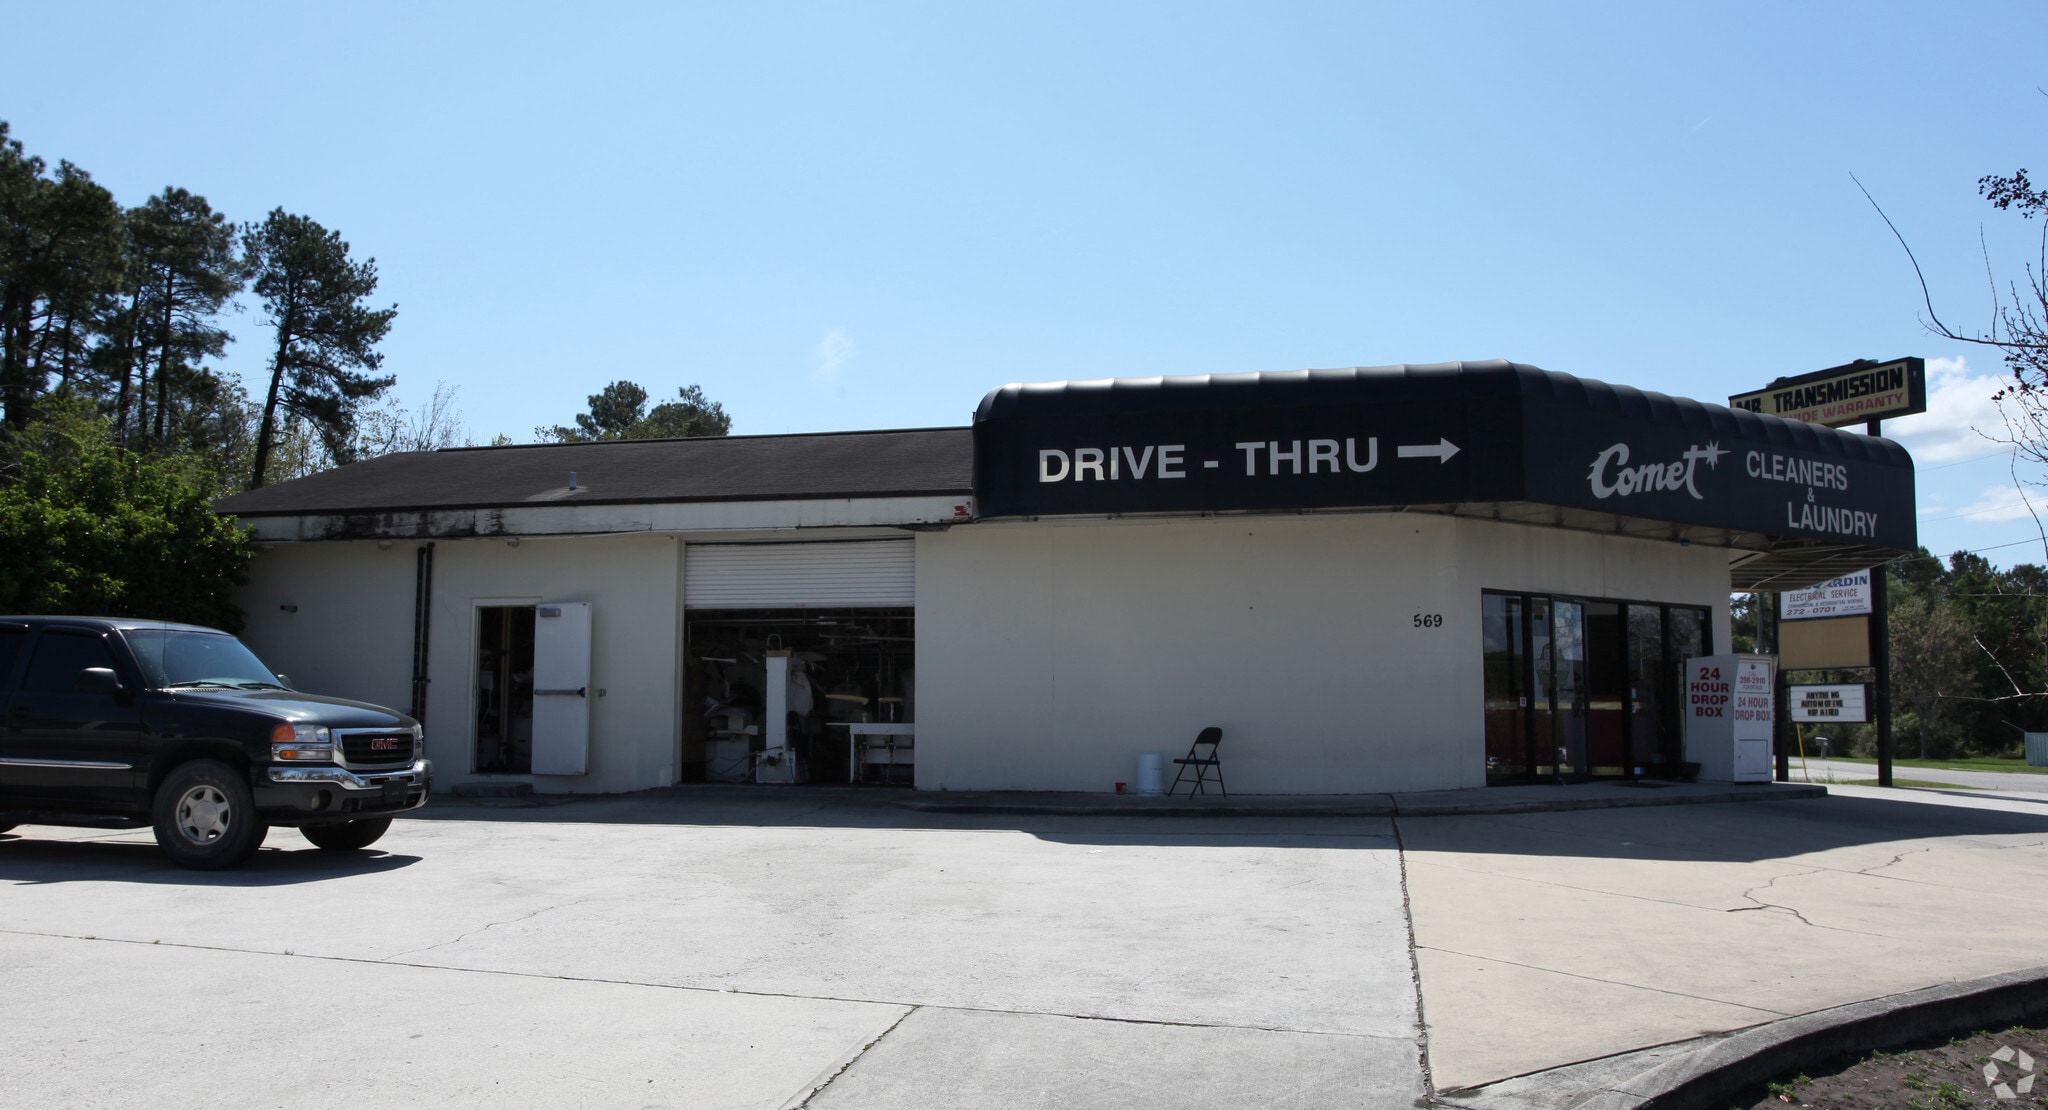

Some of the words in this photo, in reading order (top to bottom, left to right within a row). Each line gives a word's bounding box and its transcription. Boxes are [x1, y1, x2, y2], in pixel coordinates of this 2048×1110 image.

[1773, 367, 1903, 413] TRANSMISSION
[1823, 393, 1904, 418] WARRANTY
[1039, 445, 1186, 483] DRIVE
[1204, 460, 1219, 468] -
[1235, 437, 1379, 476] THRU
[1586, 443, 1704, 499] Comet
[1746, 451, 1848, 490] CLEANERS
[1807, 487, 1815, 502] &
[1788, 501, 1878, 537] LAUNDRY
[1789, 591, 1827, 602] ELECTRICAL
[1830, 588, 1858, 599] SERVICE
[1413, 613, 1443, 628] 569
[1699, 667, 1720, 680] 24
[1690, 682, 1729, 693] HOUR
[1691, 694, 1729, 705] DROP
[1737, 696, 1746, 707] 24
[1747, 697, 1769, 708] HOUR
[1695, 707, 1723, 717] BOX
[1735, 709, 1755, 720] DROP
[1755, 710, 1771, 721] BOX
[371, 738, 398, 750] GMC
